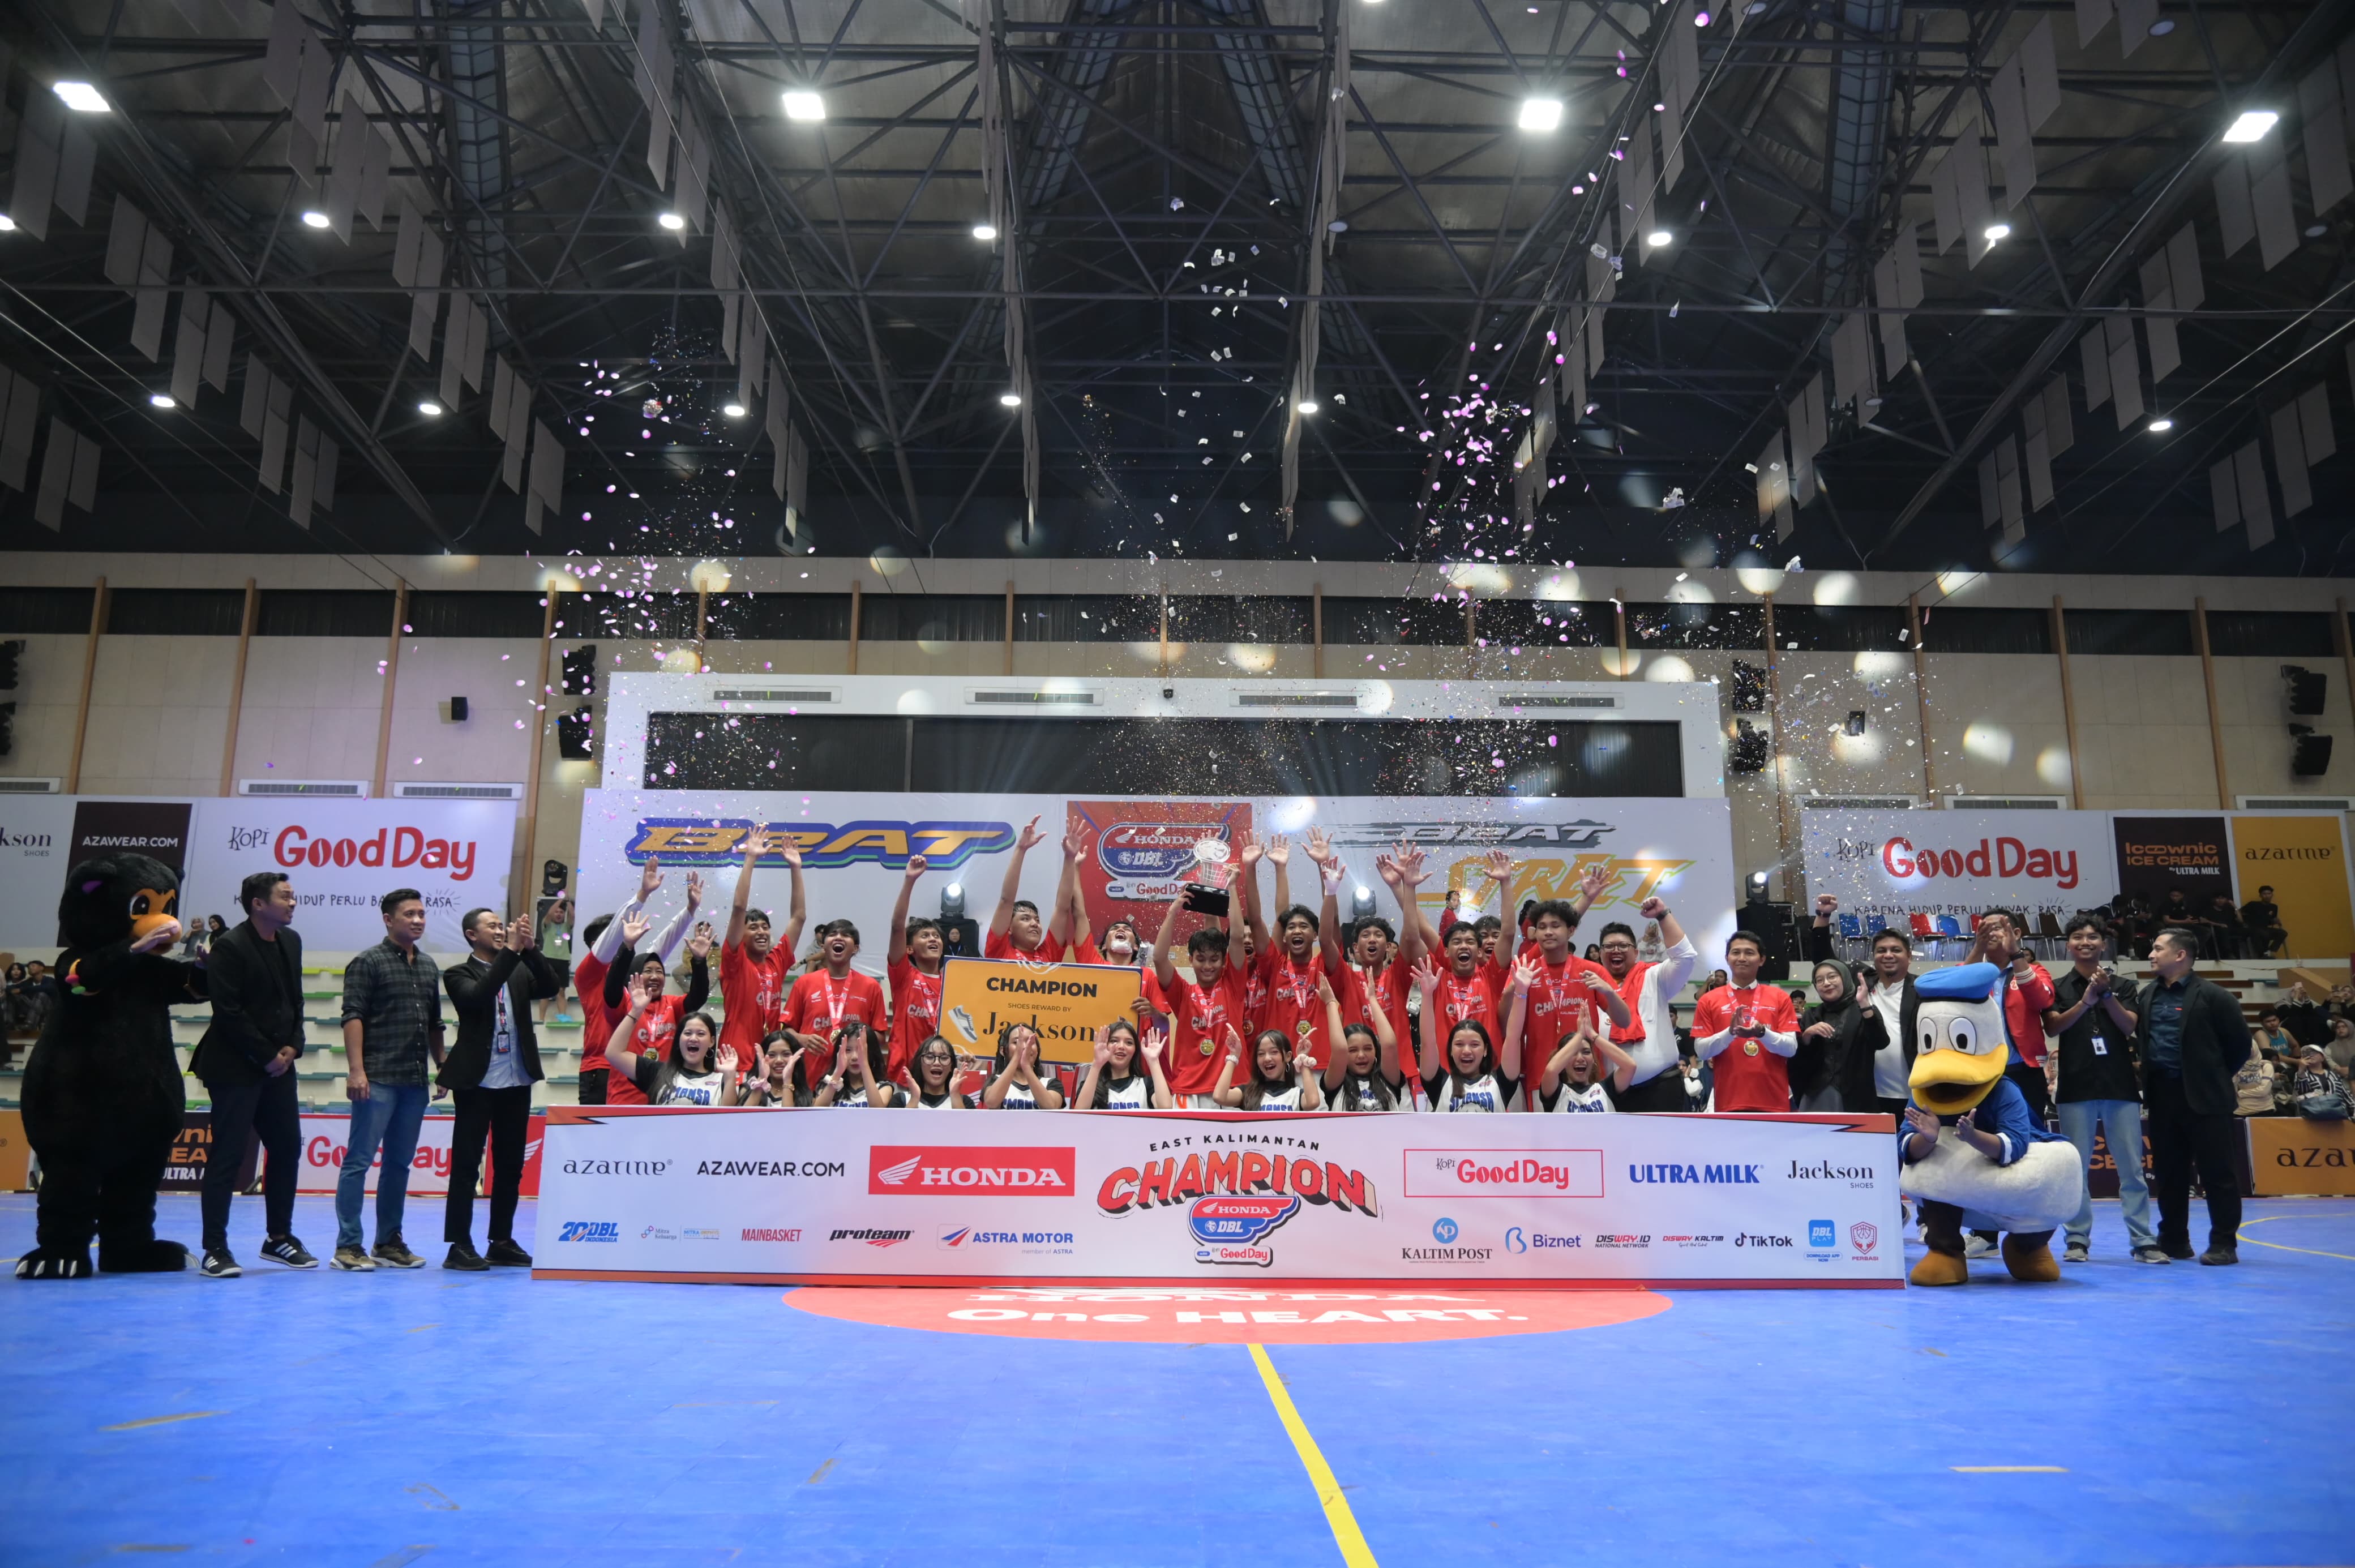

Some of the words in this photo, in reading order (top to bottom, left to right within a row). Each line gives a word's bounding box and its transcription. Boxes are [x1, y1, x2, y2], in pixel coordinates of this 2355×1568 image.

[82, 836, 178, 847] AZAWEAR.COM
[1134, 836, 1196, 844] HONDA
[1133, 852, 1163, 866] DBL
[2127, 856, 2155, 865] ICE
[2157, 856, 2219, 865] CREAM
[331, 895, 365, 906] PERLU
[426, 897, 452, 907] RASA
[1855, 905, 1905, 915] KARENA
[987, 977, 1097, 997] CHAMPION
[983, 1012, 1095, 1042] Jakson
[1150, 1137, 1192, 1152] EAST
[1203, 1134, 1320, 1151] KALIMANTAN
[563, 1159, 666, 1176] azarine
[697, 1161, 845, 1177] AZAWEAR.COM
[1629, 1164, 1699, 1183] ULTRA
[1703, 1164, 1760, 1183] MILK
[1788, 1160, 1874, 1180] Jackson
[920, 1167, 1066, 1186] HONDA
[1097, 1150, 1378, 1218] CHAMPION
[1217, 1220, 1243, 1232] DBL
[1812, 1227, 1832, 1237] DBL
[742, 1228, 802, 1242] MAINBASKET
[829, 1228, 911, 1242] proteam
[973, 1232, 1018, 1243] ASTRA
[1022, 1233, 1073, 1243] MOTOR
[1533, 1234, 1581, 1248] Biznet
[1596, 1235, 1651, 1243] DISWAY.ID
[1749, 1236, 1793, 1247] TikTok
[1402, 1248, 1454, 1259] KALTIM
[1458, 1248, 1493, 1259] POST
[947, 1308, 1150, 1322] One
